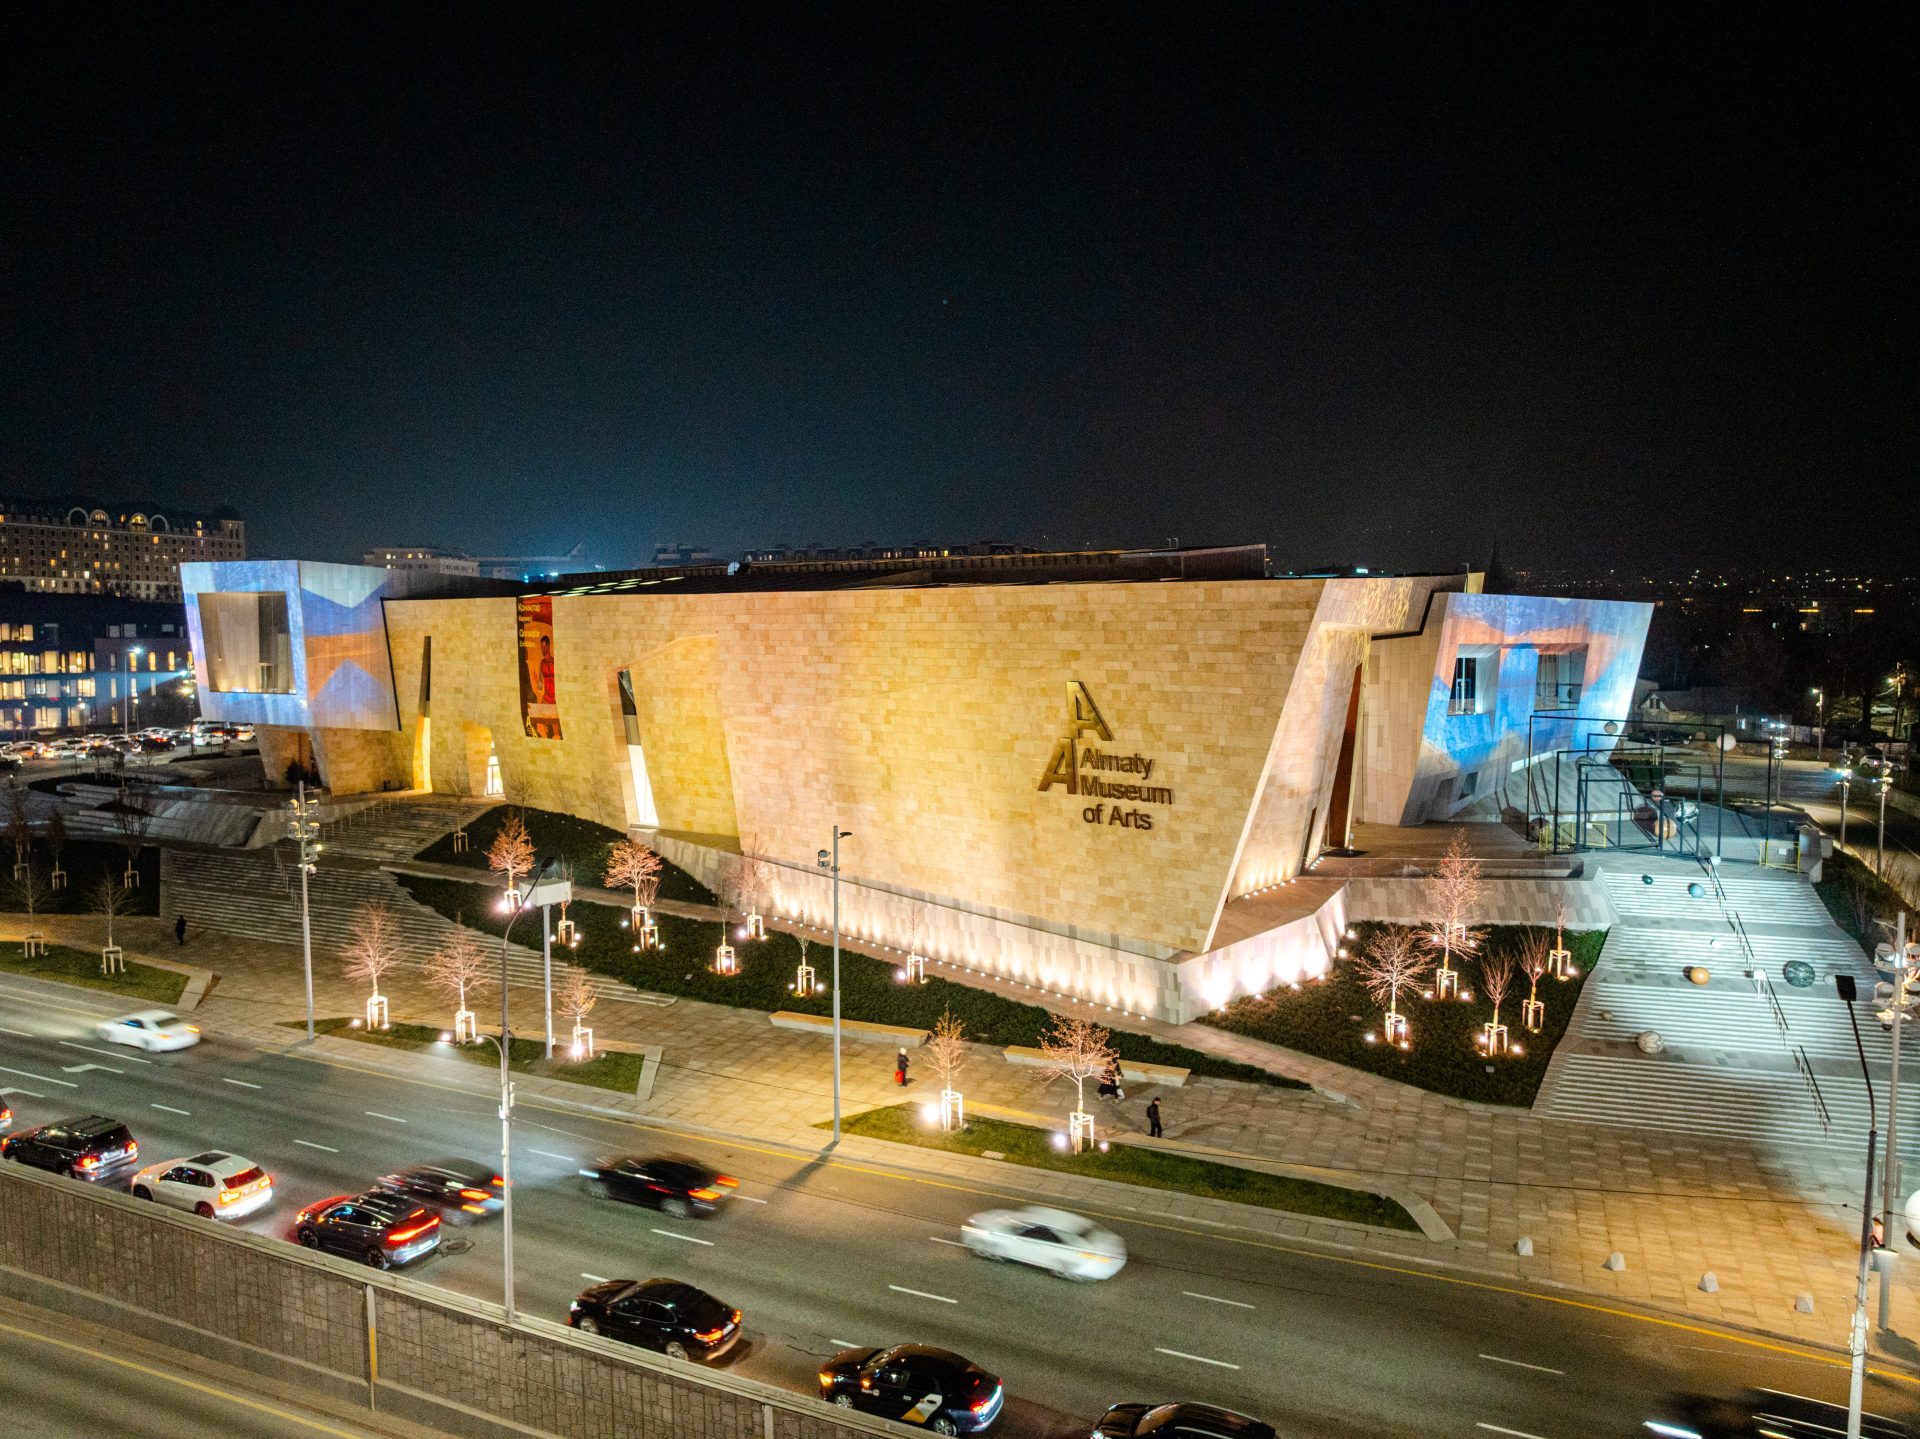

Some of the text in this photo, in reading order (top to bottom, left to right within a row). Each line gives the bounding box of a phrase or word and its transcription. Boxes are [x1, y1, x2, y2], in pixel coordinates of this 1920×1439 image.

[1066, 681, 1114, 741] A
[1038, 737, 1077, 795] A
[1080, 747, 1153, 780] Almaty
[1080, 775, 1173, 805] Museum
[1083, 803, 1153, 831] of Arts
